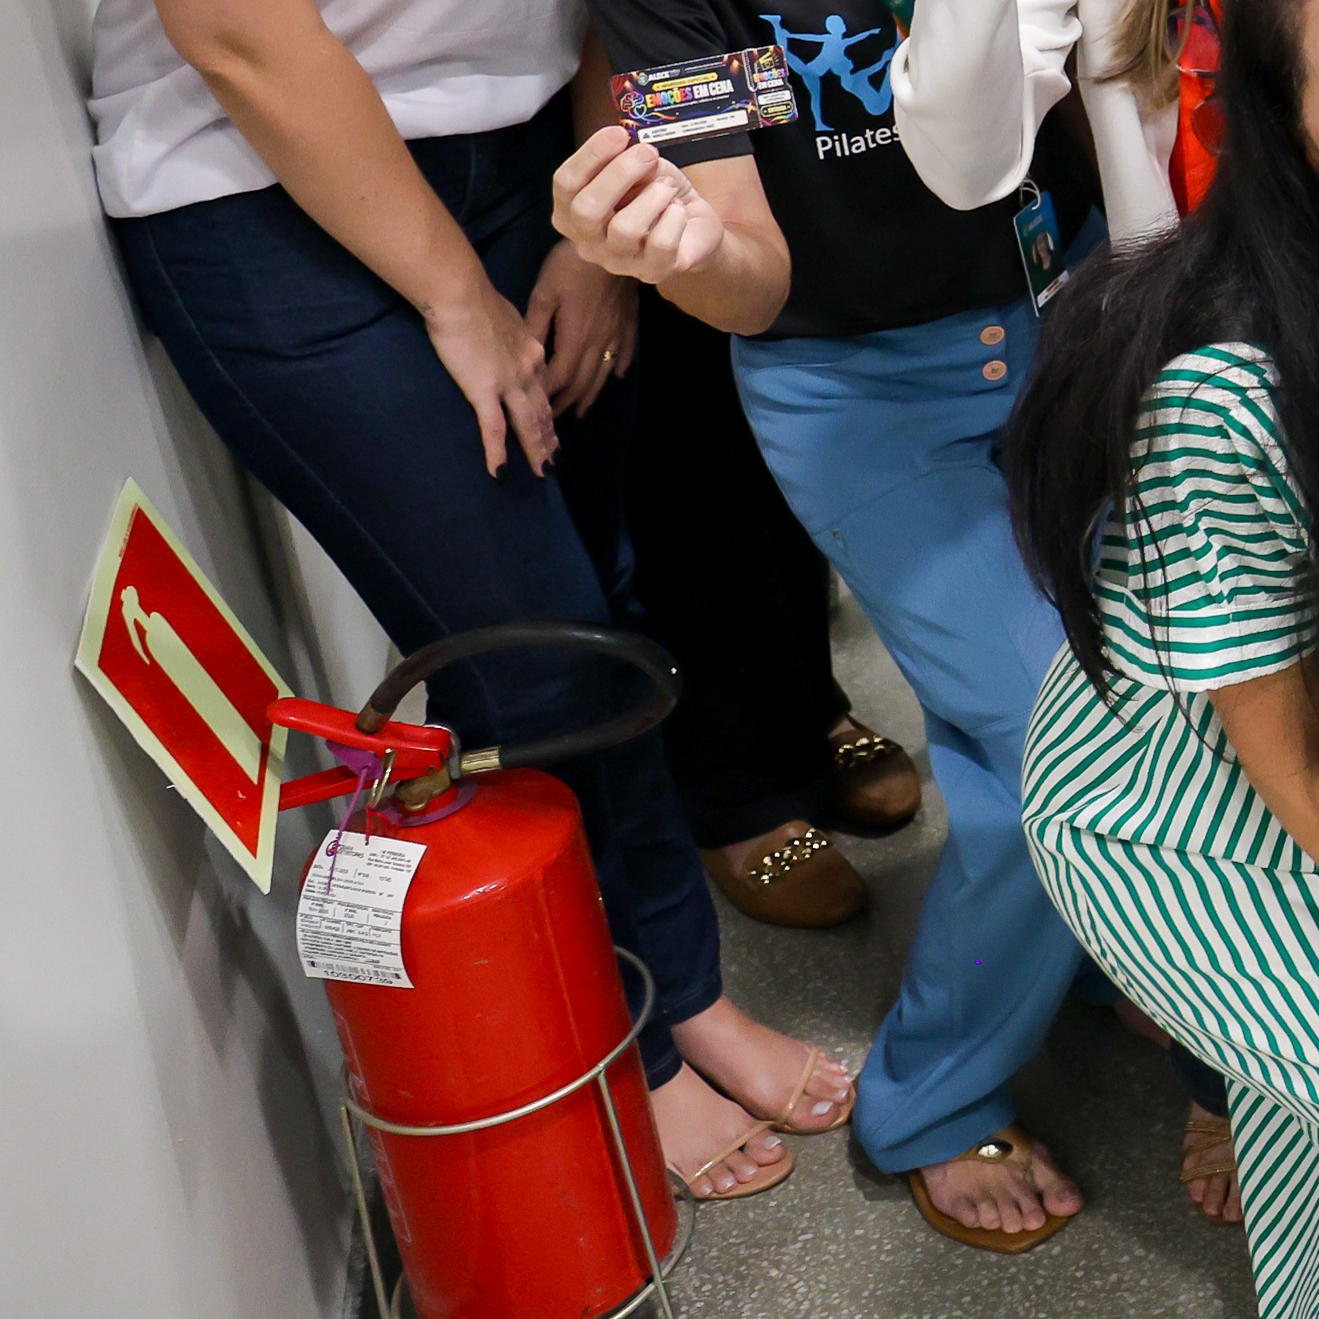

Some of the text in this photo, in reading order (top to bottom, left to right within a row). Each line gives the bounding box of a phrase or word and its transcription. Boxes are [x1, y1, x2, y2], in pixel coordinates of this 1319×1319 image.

[645, 87, 693, 108] EMOÇÕES
[693, 86, 709, 99] EM
[709, 79, 735, 96] CENA
[815, 123, 900, 160] Pilates
